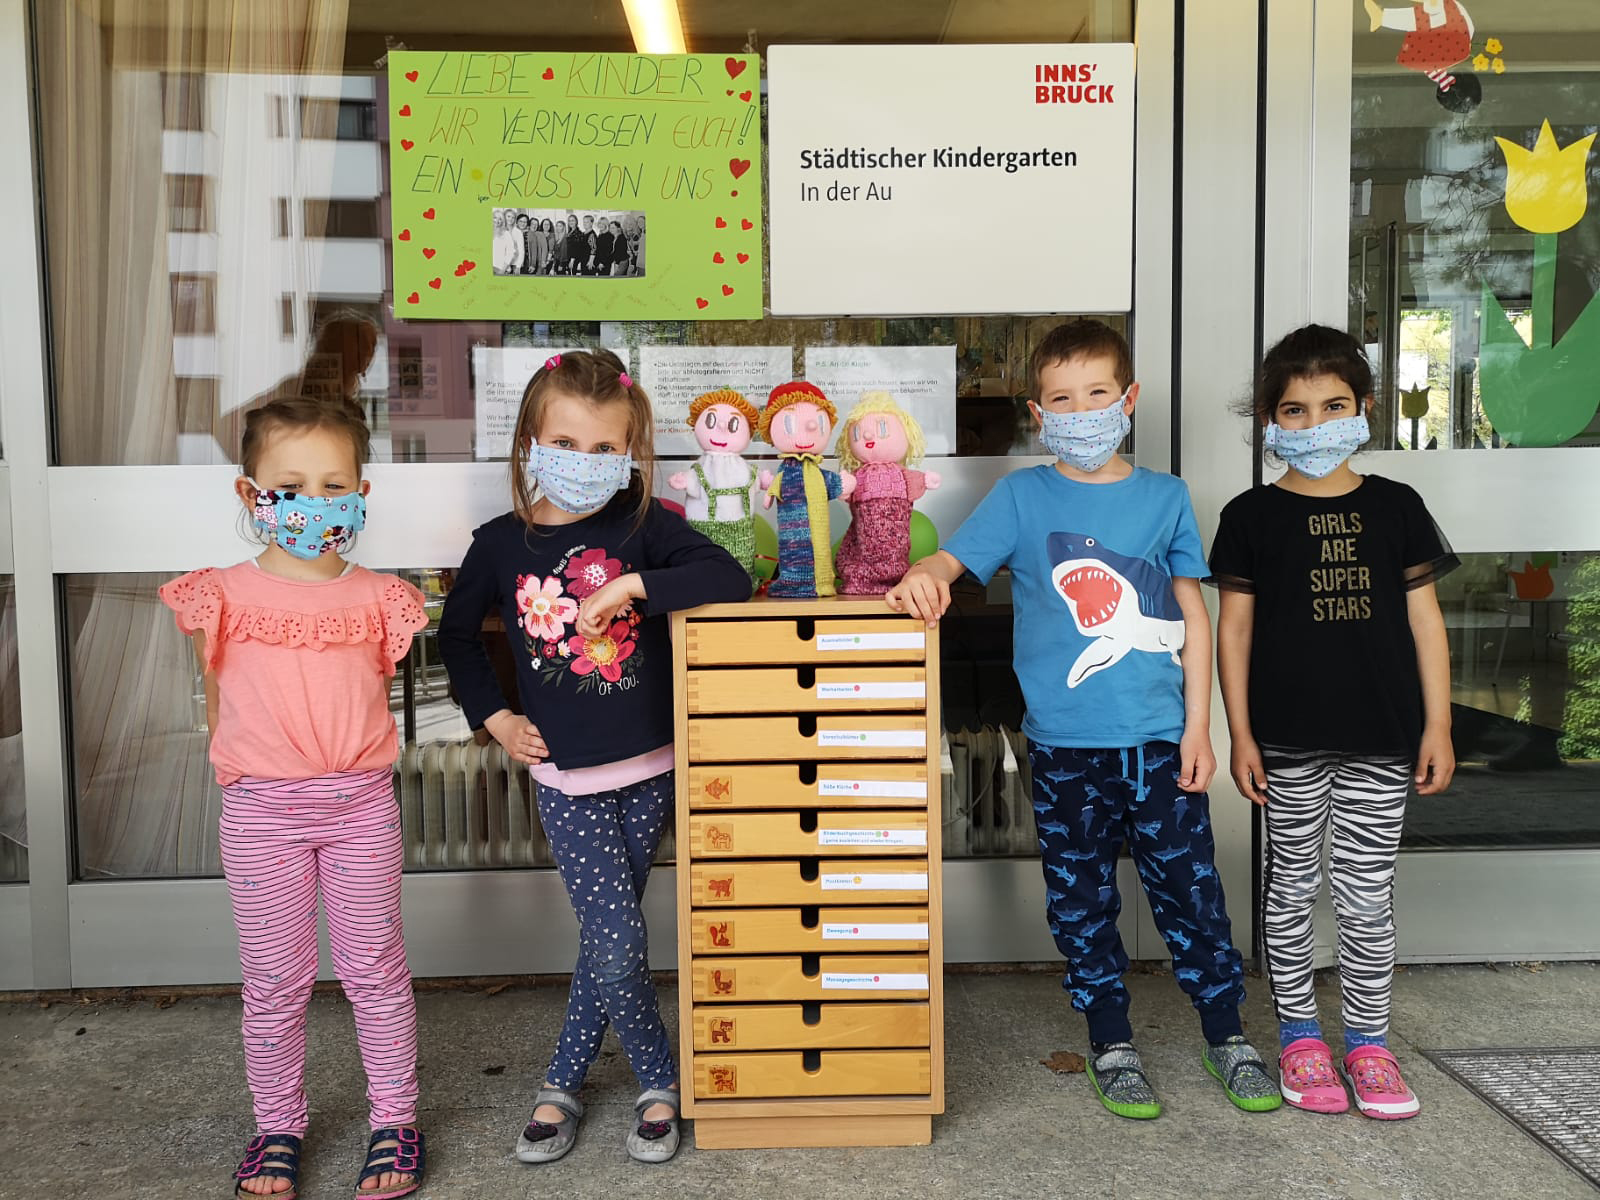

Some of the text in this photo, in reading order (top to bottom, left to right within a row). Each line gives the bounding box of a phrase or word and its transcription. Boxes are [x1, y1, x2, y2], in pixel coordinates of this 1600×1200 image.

[427, 53, 703, 96] LIEBE KINDER
[1035, 85, 1115, 104] BRUCK
[429, 104, 757, 149] WIR VERMISSEN EUCH!
[800, 146, 1078, 173] Städtischer Kindergarten
[412, 155, 464, 194] EIN
[487, 159, 574, 201] GRUSS
[594, 162, 644, 199] VON
[660, 165, 714, 200] UNS
[801, 180, 893, 201] In der Au
[1308, 512, 1363, 536] GIRLS
[1320, 538, 1358, 562] ARE
[1310, 566, 1371, 592] SUPER
[1313, 595, 1372, 622] STARS
[598, 681, 613, 696] OF
